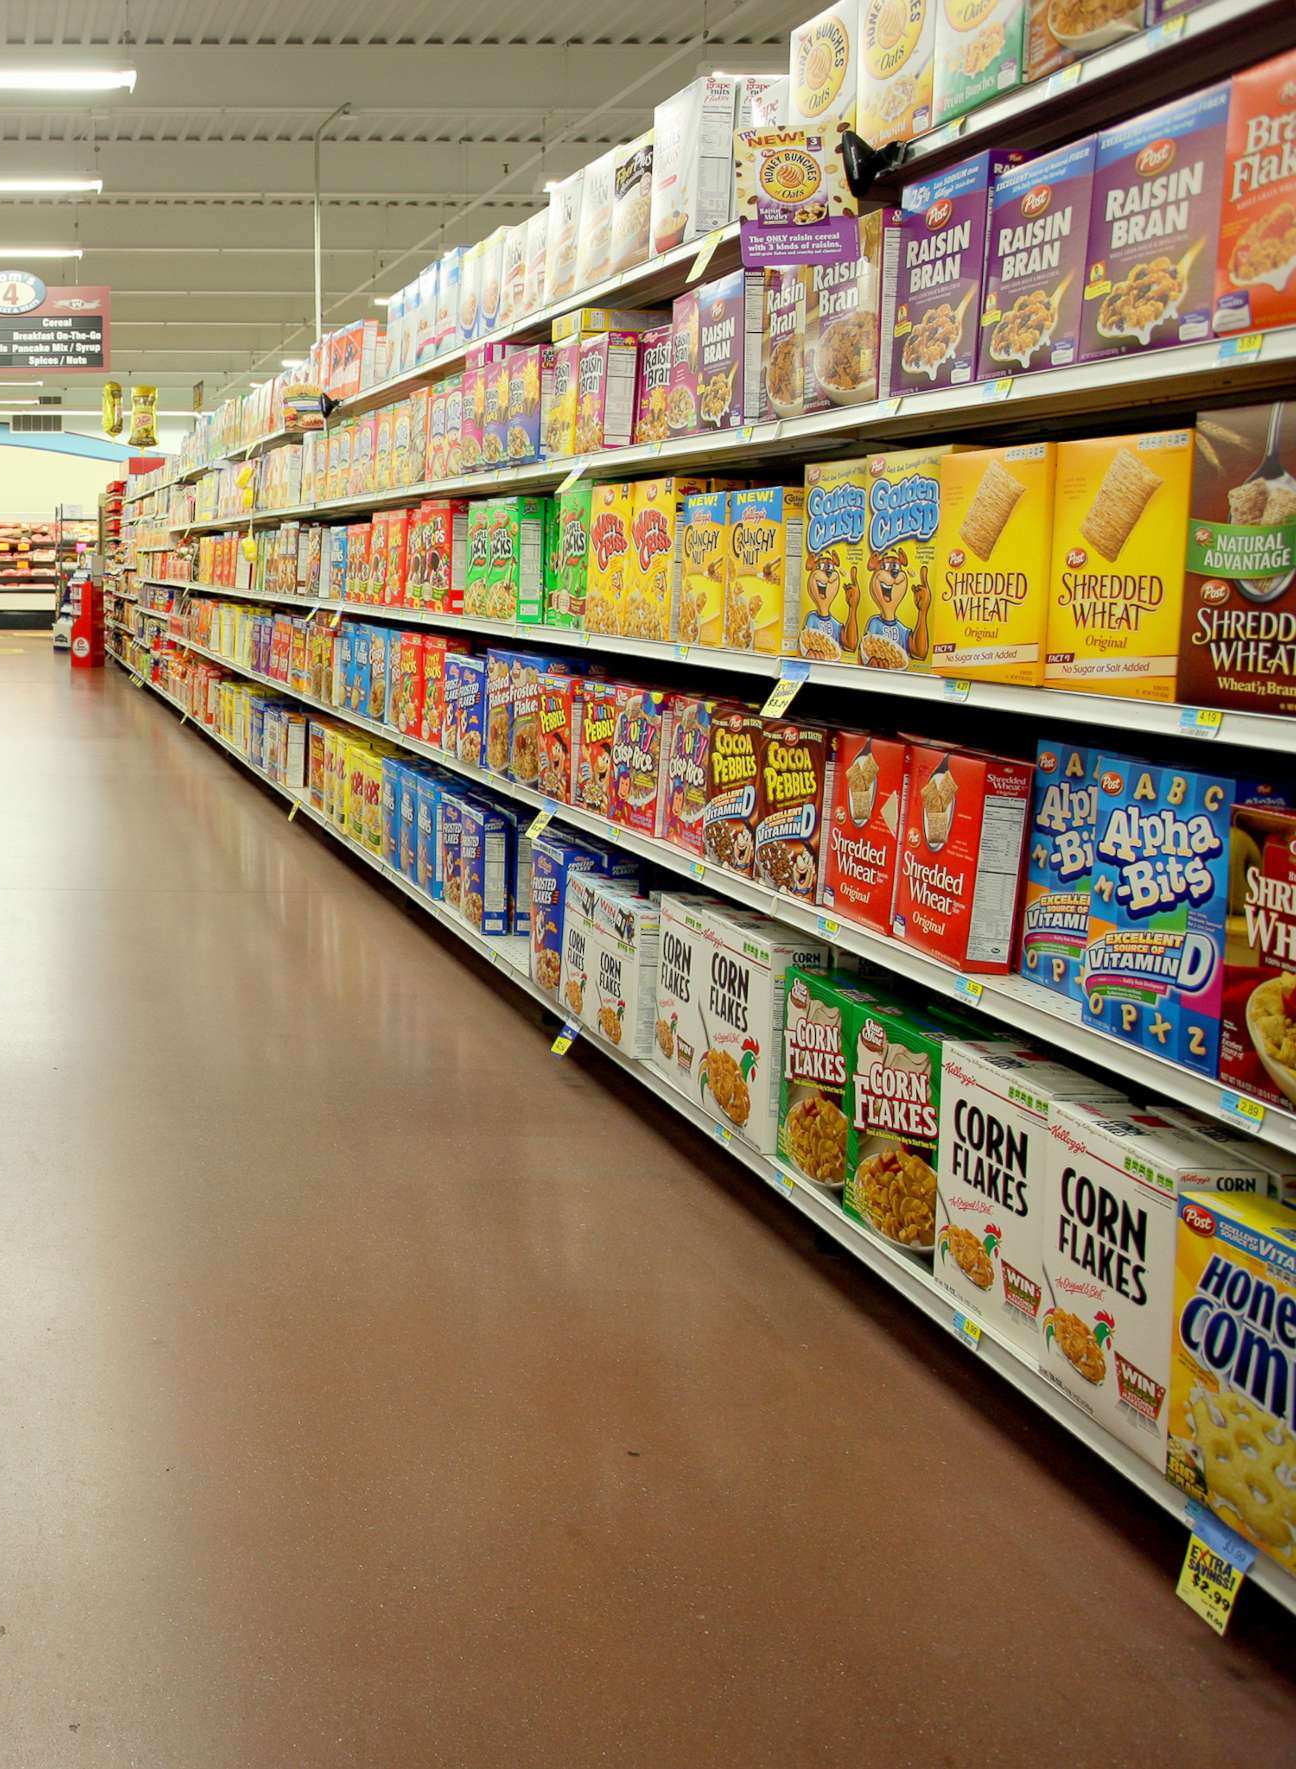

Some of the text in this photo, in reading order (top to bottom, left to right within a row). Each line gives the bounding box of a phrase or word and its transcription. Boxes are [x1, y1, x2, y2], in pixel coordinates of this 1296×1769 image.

[737, 129, 758, 141] TRY
[747, 131, 805, 147] NEW!
[763, 153, 817, 183] HONEY BUNCHES
[782, 188, 805, 199] Oats
[1105, 160, 1204, 222] RAISIN
[926, 203, 952, 225] Post
[1110, 200, 1189, 249] BRAN
[748, 243, 766, 251] with
[768, 243, 774, 251] 3
[776, 242, 798, 250] kinds
[800, 241, 809, 249] of
[749, 232, 840, 244] The ONLY raisin cereal
[906, 220, 971, 268] RAISIN
[998, 206, 1072, 257] RAISIN
[813, 258, 868, 293] Raisin
[910, 254, 961, 293] BRAN
[1001, 241, 1061, 282] BRAN
[3, 283, 19, 305] 4
[819, 287, 859, 318] Bran
[13, 331, 101, 340] Breakfast On-The-Go
[42, 318, 72, 327] Cereal
[12, 343, 50, 353] Pancake
[52, 343, 68, 352] Mix
[76, 343, 100, 353] Syrup
[28, 356, 58, 366] Spices
[66, 356, 87, 365] Nuts
[688, 495, 718, 507] NEW!
[737, 490, 774, 505] NEW!
[810, 487, 866, 515] Golden
[872, 476, 940, 509] Golden
[732, 522, 777, 558] CRUNCHY
[1216, 532, 1284, 552] NATURAL
[743, 549, 759, 565] NUT
[1203, 548, 1291, 571] ADVANTAGE
[941, 571, 1028, 602] SHREDDED
[1058, 573, 1164, 607] SHREDDED
[1201, 581, 1229, 599] Post
[953, 597, 1021, 623] WHEAT
[1072, 602, 1158, 632] WHEAT
[964, 627, 999, 641] Original
[1085, 634, 1128, 652] Original
[1061, 665, 1072, 673] No
[1073, 664, 1095, 676] Sugar
[1105, 663, 1119, 672] Salt
[1121, 662, 1150, 672] Added
[1217, 677, 1266, 695] Wheat'n
[1198, 712, 1217, 723] 4.19
[715, 728, 753, 754] COCOA
[767, 742, 812, 770] COCOA
[711, 752, 757, 785] PEBBLES
[764, 767, 817, 801] PEBBLES
[1101, 777, 1122, 791] Post
[1132, 773, 1224, 812] A B C
[831, 826, 887, 867] Shredded
[1098, 805, 1221, 862] Alpha
[837, 850, 877, 886] Wheat
[902, 850, 965, 897] Shredded
[840, 882, 871, 905] Original
[909, 876, 953, 916] Wheat
[1116, 857, 1213, 911] -Bits
[912, 910, 946, 936] Original
[663, 931, 693, 977] CORN
[1105, 932, 1184, 948] EXCELLENT
[1113, 944, 1167, 955] SOURCE OF
[711, 951, 750, 1001] CORN
[1089, 947, 1180, 978] VITAMIN
[1178, 931, 1215, 991] D
[661, 962, 691, 1004] FLAKES
[709, 984, 749, 1034] FLAKES
[796, 1017, 839, 1055] CORN
[784, 1030, 848, 1085] FLAKES
[870, 1063, 929, 1104] CORN
[944, 1062, 977, 1087] Kellogg's
[852, 1074, 939, 1139] FLAKES
[1240, 1101, 1260, 1117] 2.89
[953, 1099, 1029, 1179] CORN
[1050, 1125, 1087, 1154] Kellogg's
[952, 1141, 1028, 1218] FLAKES
[1216, 1176, 1257, 1193] CORN
[1060, 1166, 1148, 1262] CORN
[1185, 1209, 1214, 1231] Post
[1059, 1214, 1147, 1307] FLAKES
[1187, 1558, 1237, 1593] SAVINGS!
[1190, 1543, 1233, 1579] EXTRA
[1191, 1574, 1232, 1612] $2.99
